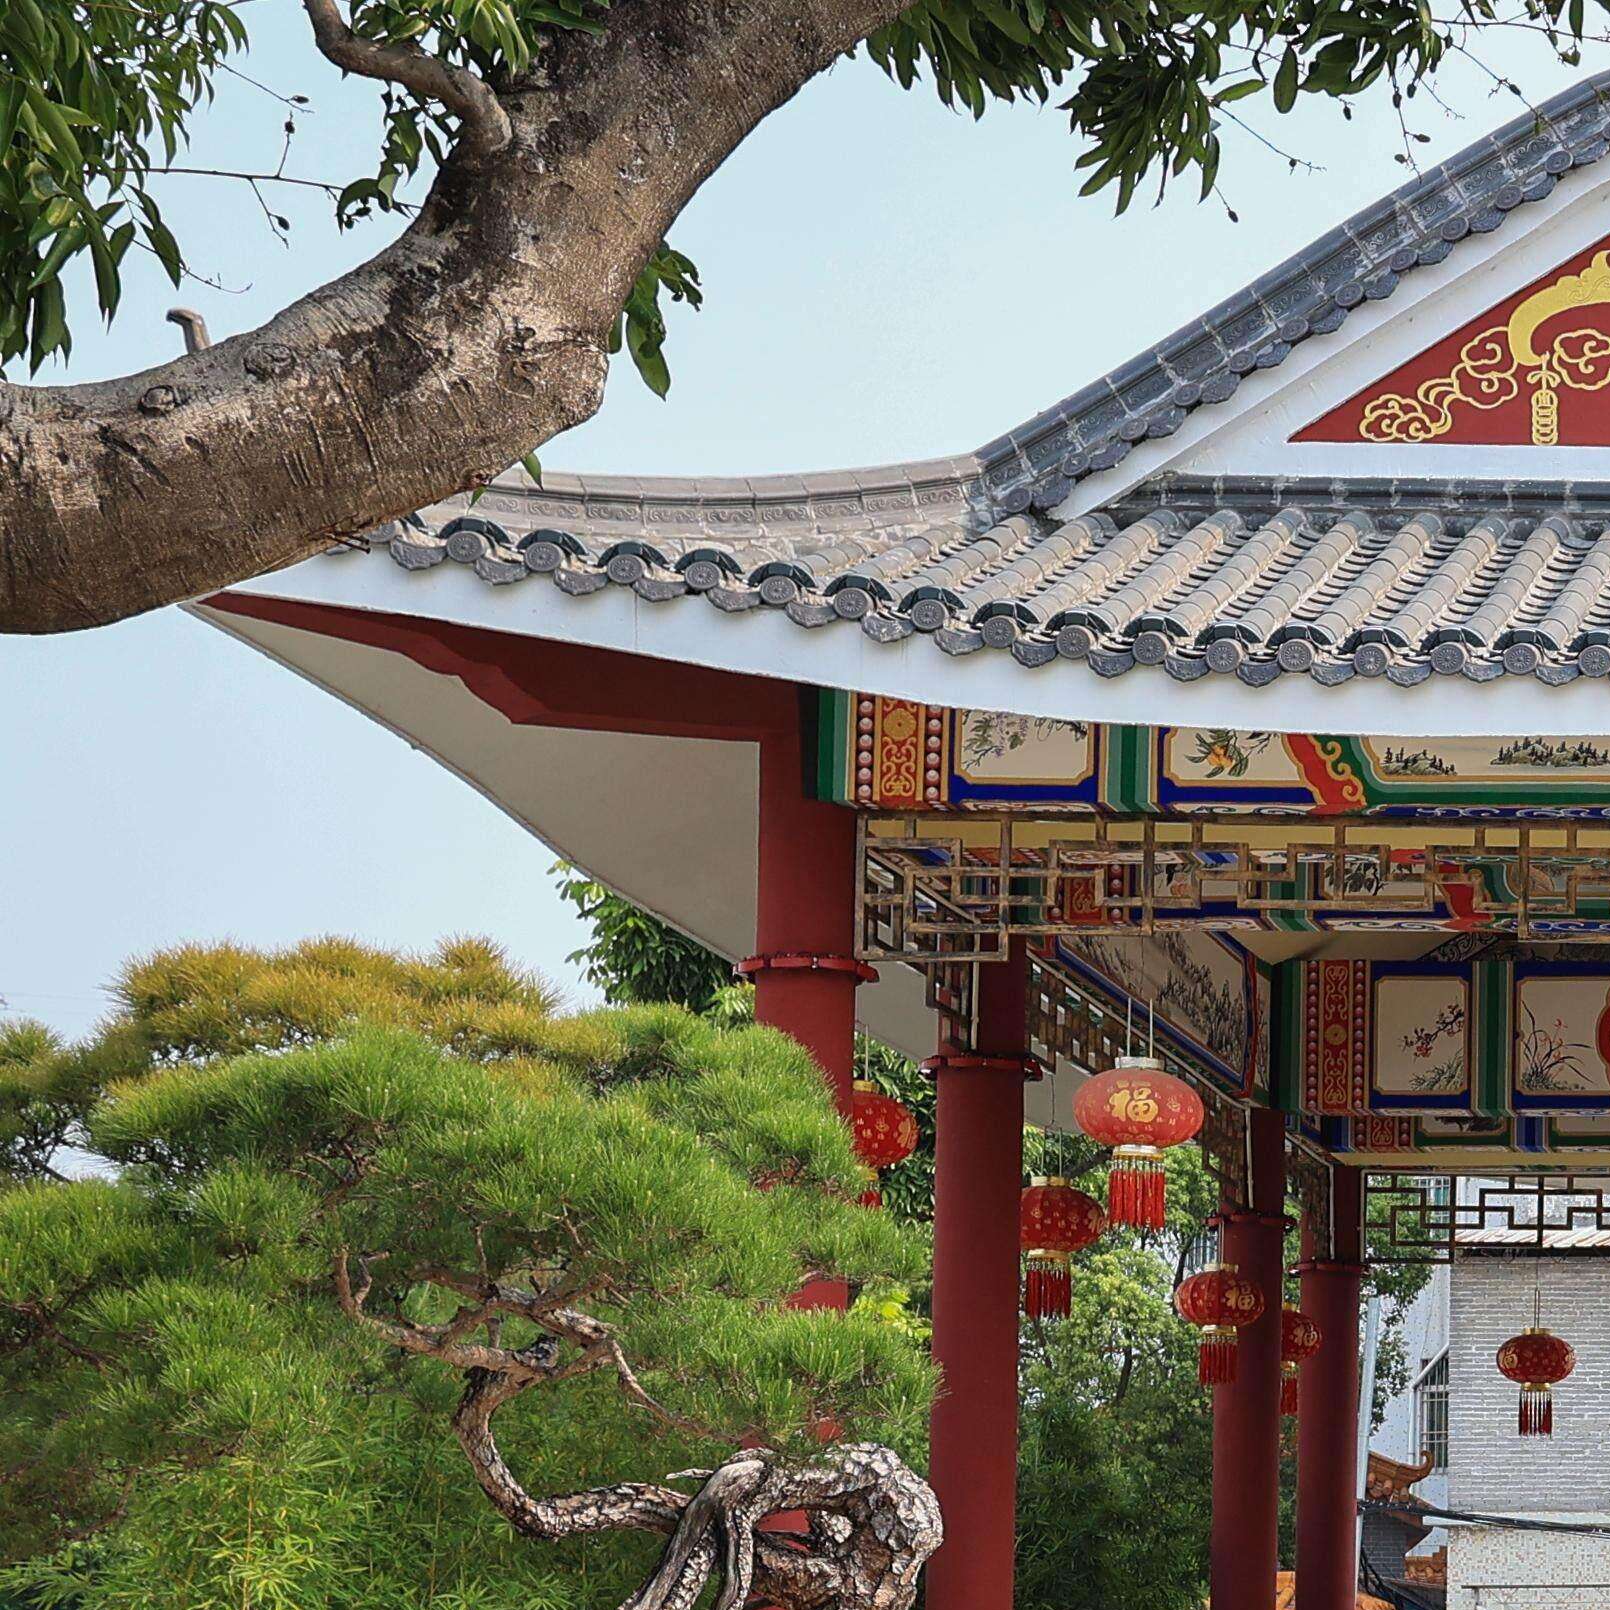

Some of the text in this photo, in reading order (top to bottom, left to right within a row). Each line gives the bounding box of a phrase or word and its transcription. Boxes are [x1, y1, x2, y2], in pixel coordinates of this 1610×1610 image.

[1108, 1080, 1159, 1123] 福
[1224, 1280, 1255, 1311] 福
[1293, 1318, 1318, 1347] 福
